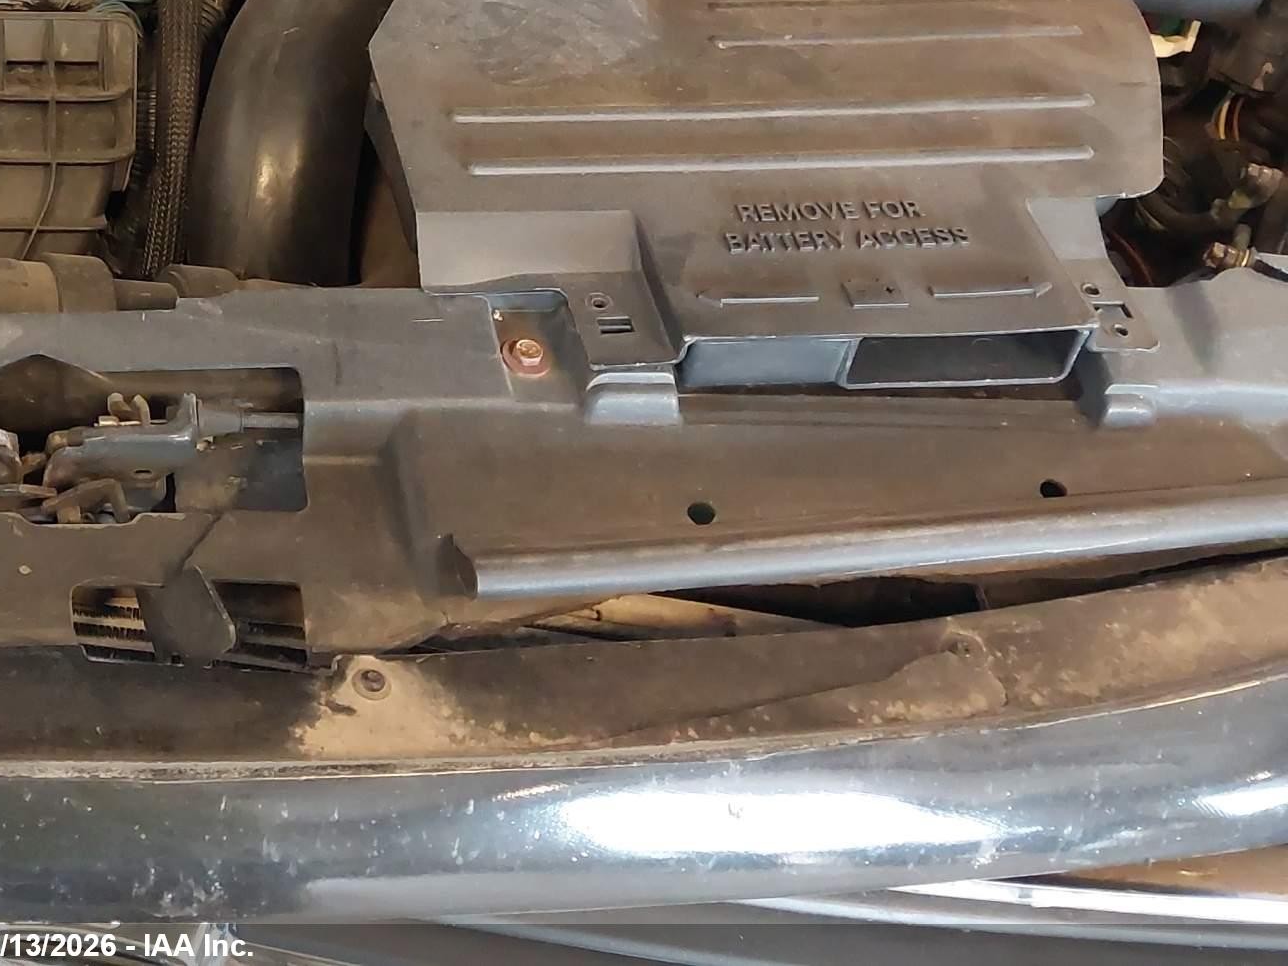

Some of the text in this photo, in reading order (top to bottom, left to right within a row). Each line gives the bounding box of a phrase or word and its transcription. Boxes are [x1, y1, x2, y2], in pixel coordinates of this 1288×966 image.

[735, 200, 926, 223] REMOVE FOR
[725, 227, 970, 255] BATTERY ACCESS
